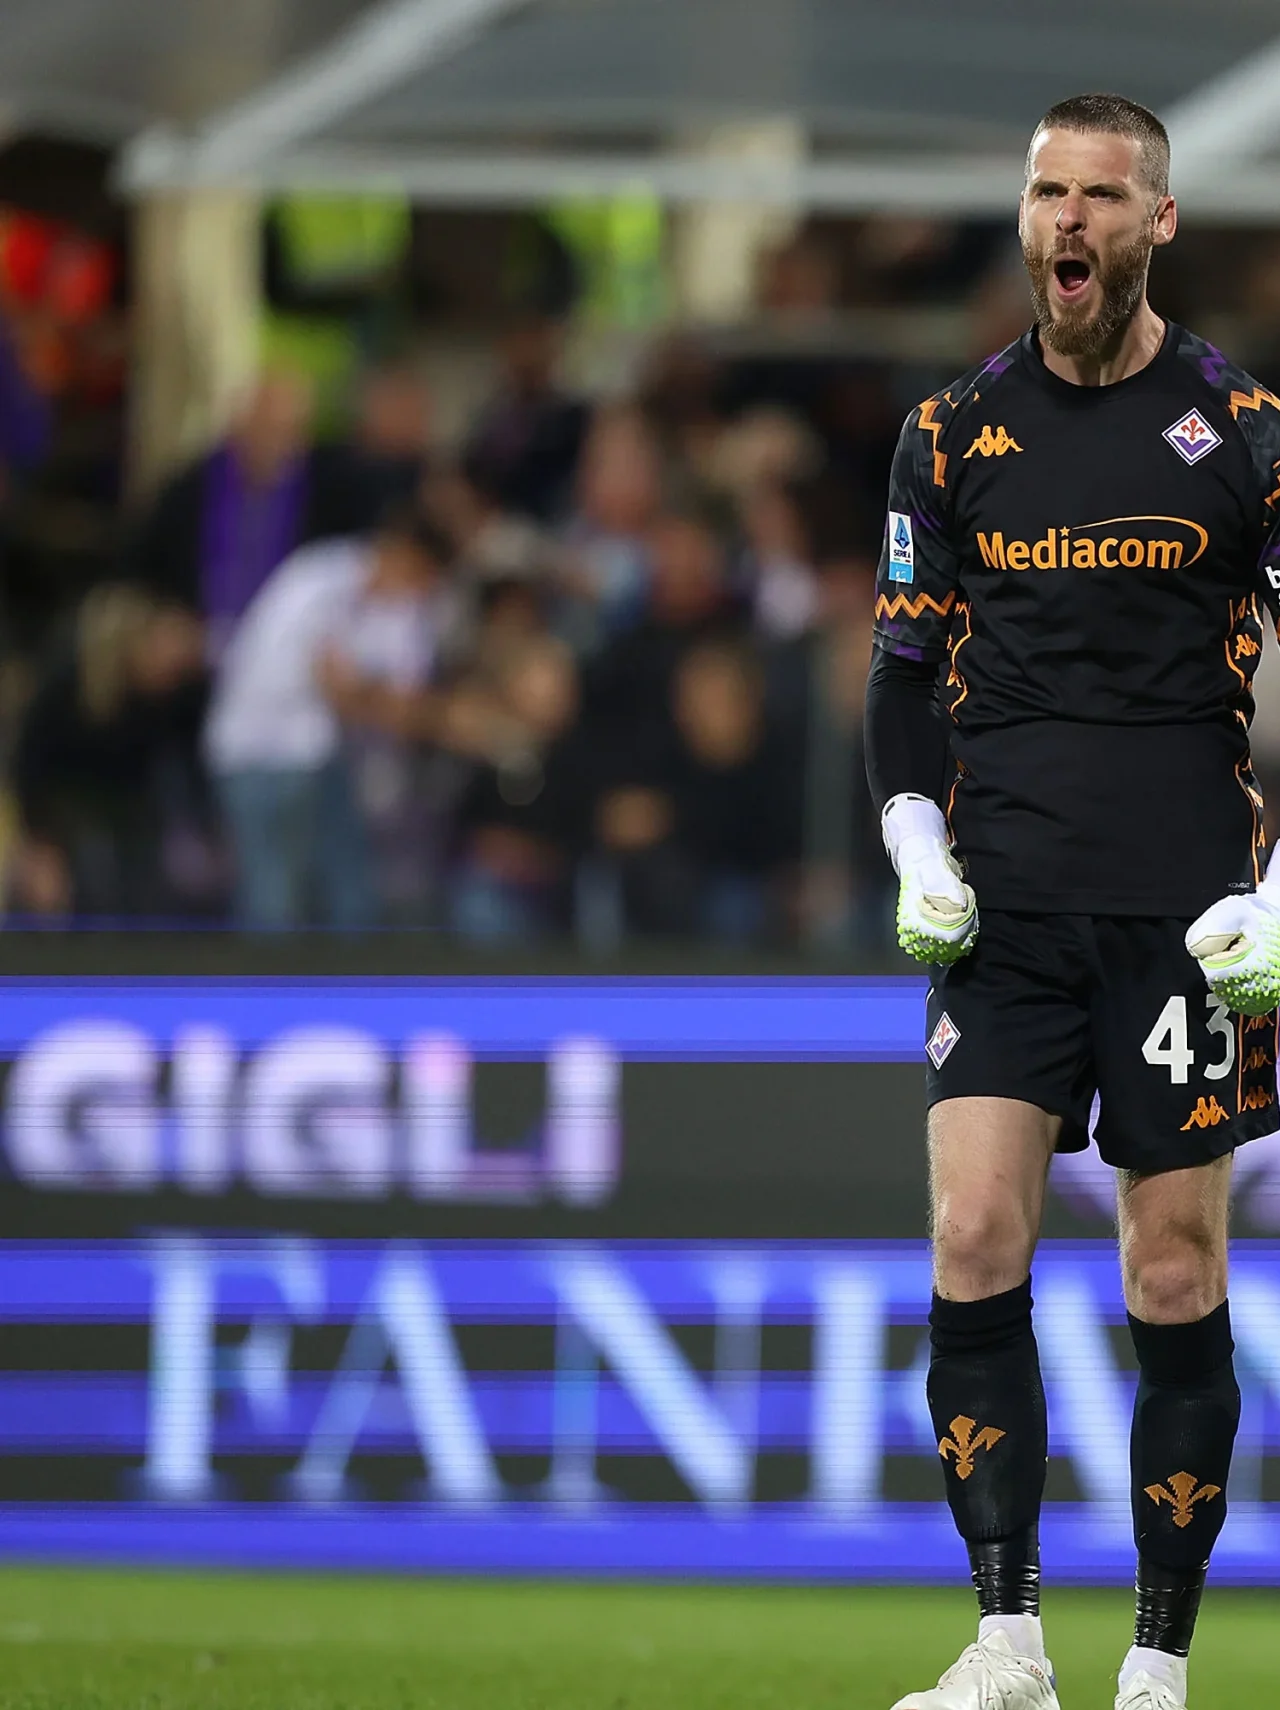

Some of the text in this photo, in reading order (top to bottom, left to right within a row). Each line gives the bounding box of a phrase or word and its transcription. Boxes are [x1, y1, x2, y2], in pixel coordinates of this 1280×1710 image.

[976, 525, 1184, 571] Mediacom
[1141, 993, 1235, 1084] 43
[4, 1018, 624, 1206] GIGLI
